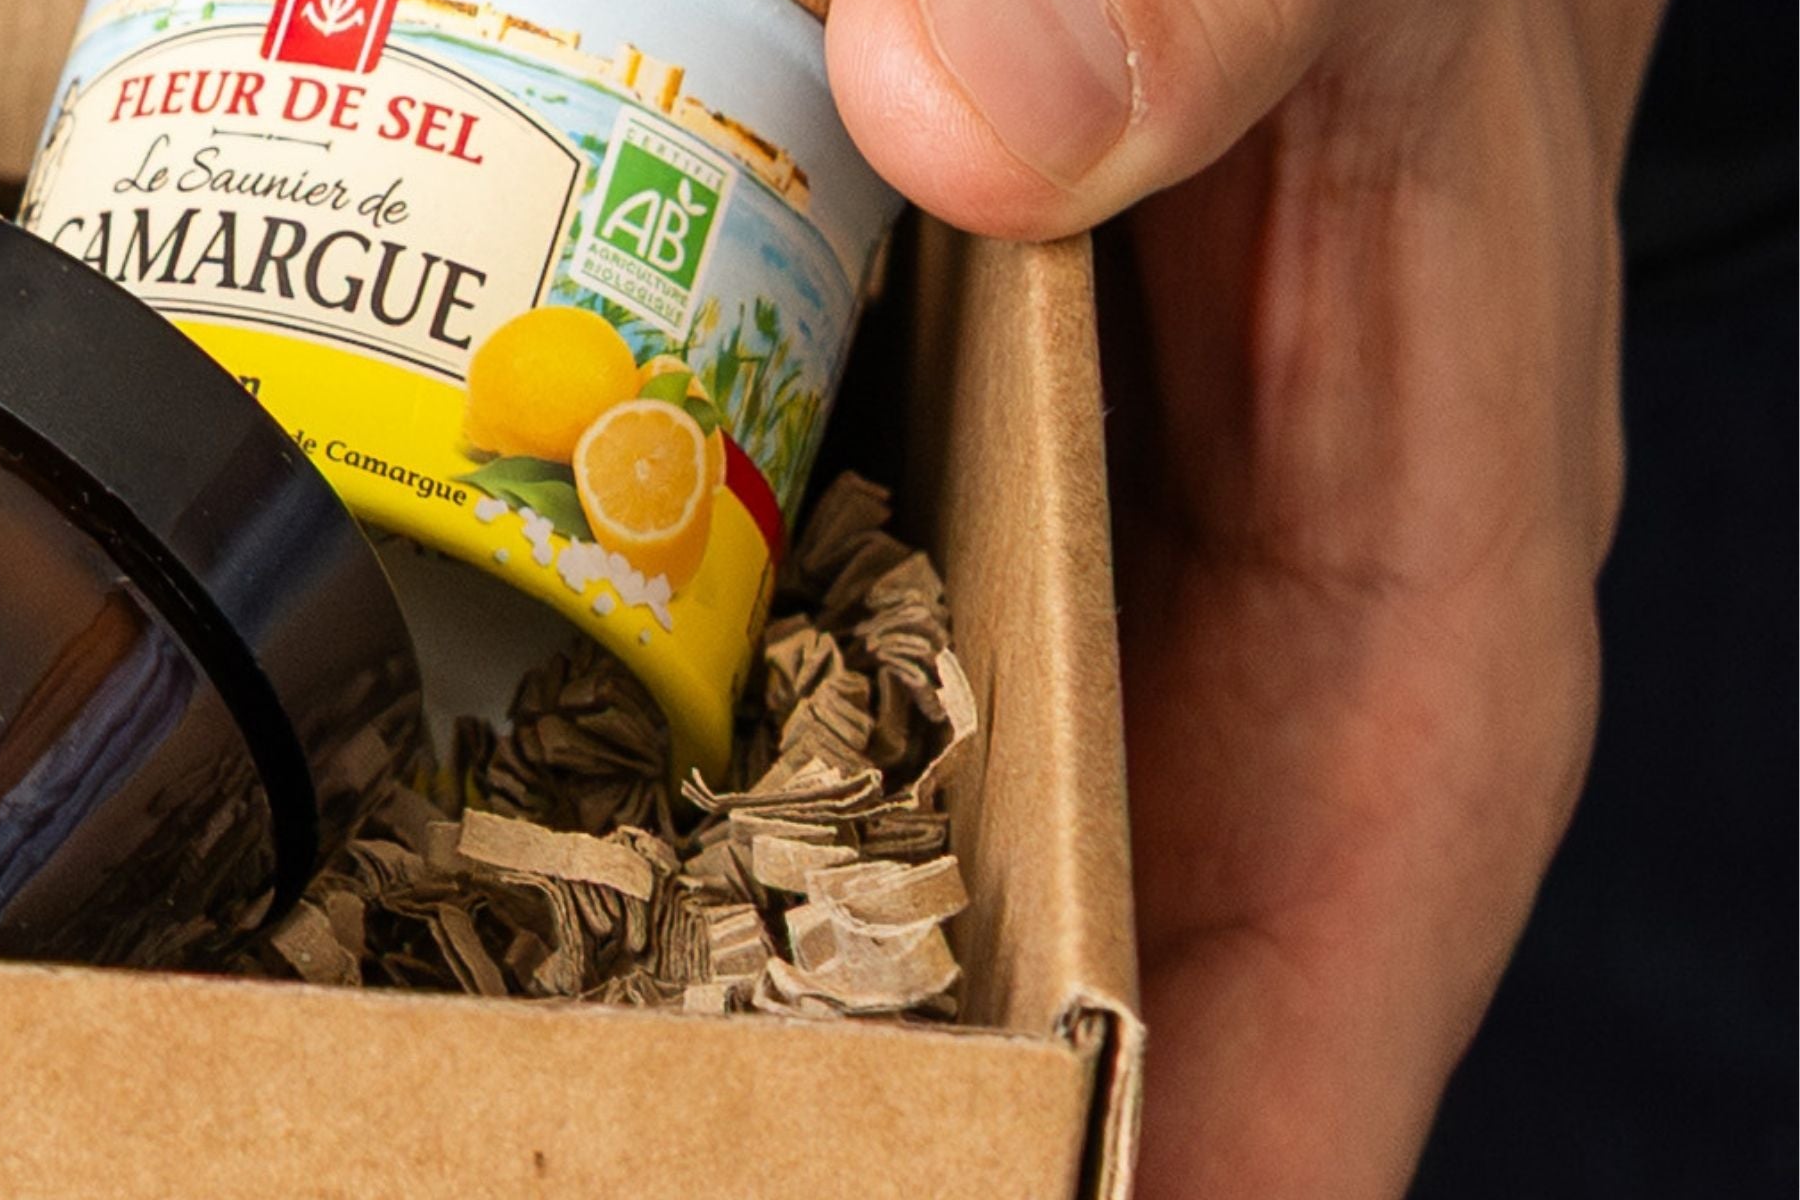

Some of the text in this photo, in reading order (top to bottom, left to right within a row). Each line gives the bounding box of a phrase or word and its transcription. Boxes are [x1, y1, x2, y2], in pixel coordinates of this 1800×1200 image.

[108, 69, 485, 165] FLEUR DE SEL
[113, 133, 411, 229] Le Saunier de
[600, 187, 688, 273] AB
[325, 439, 468, 507] Camargue
